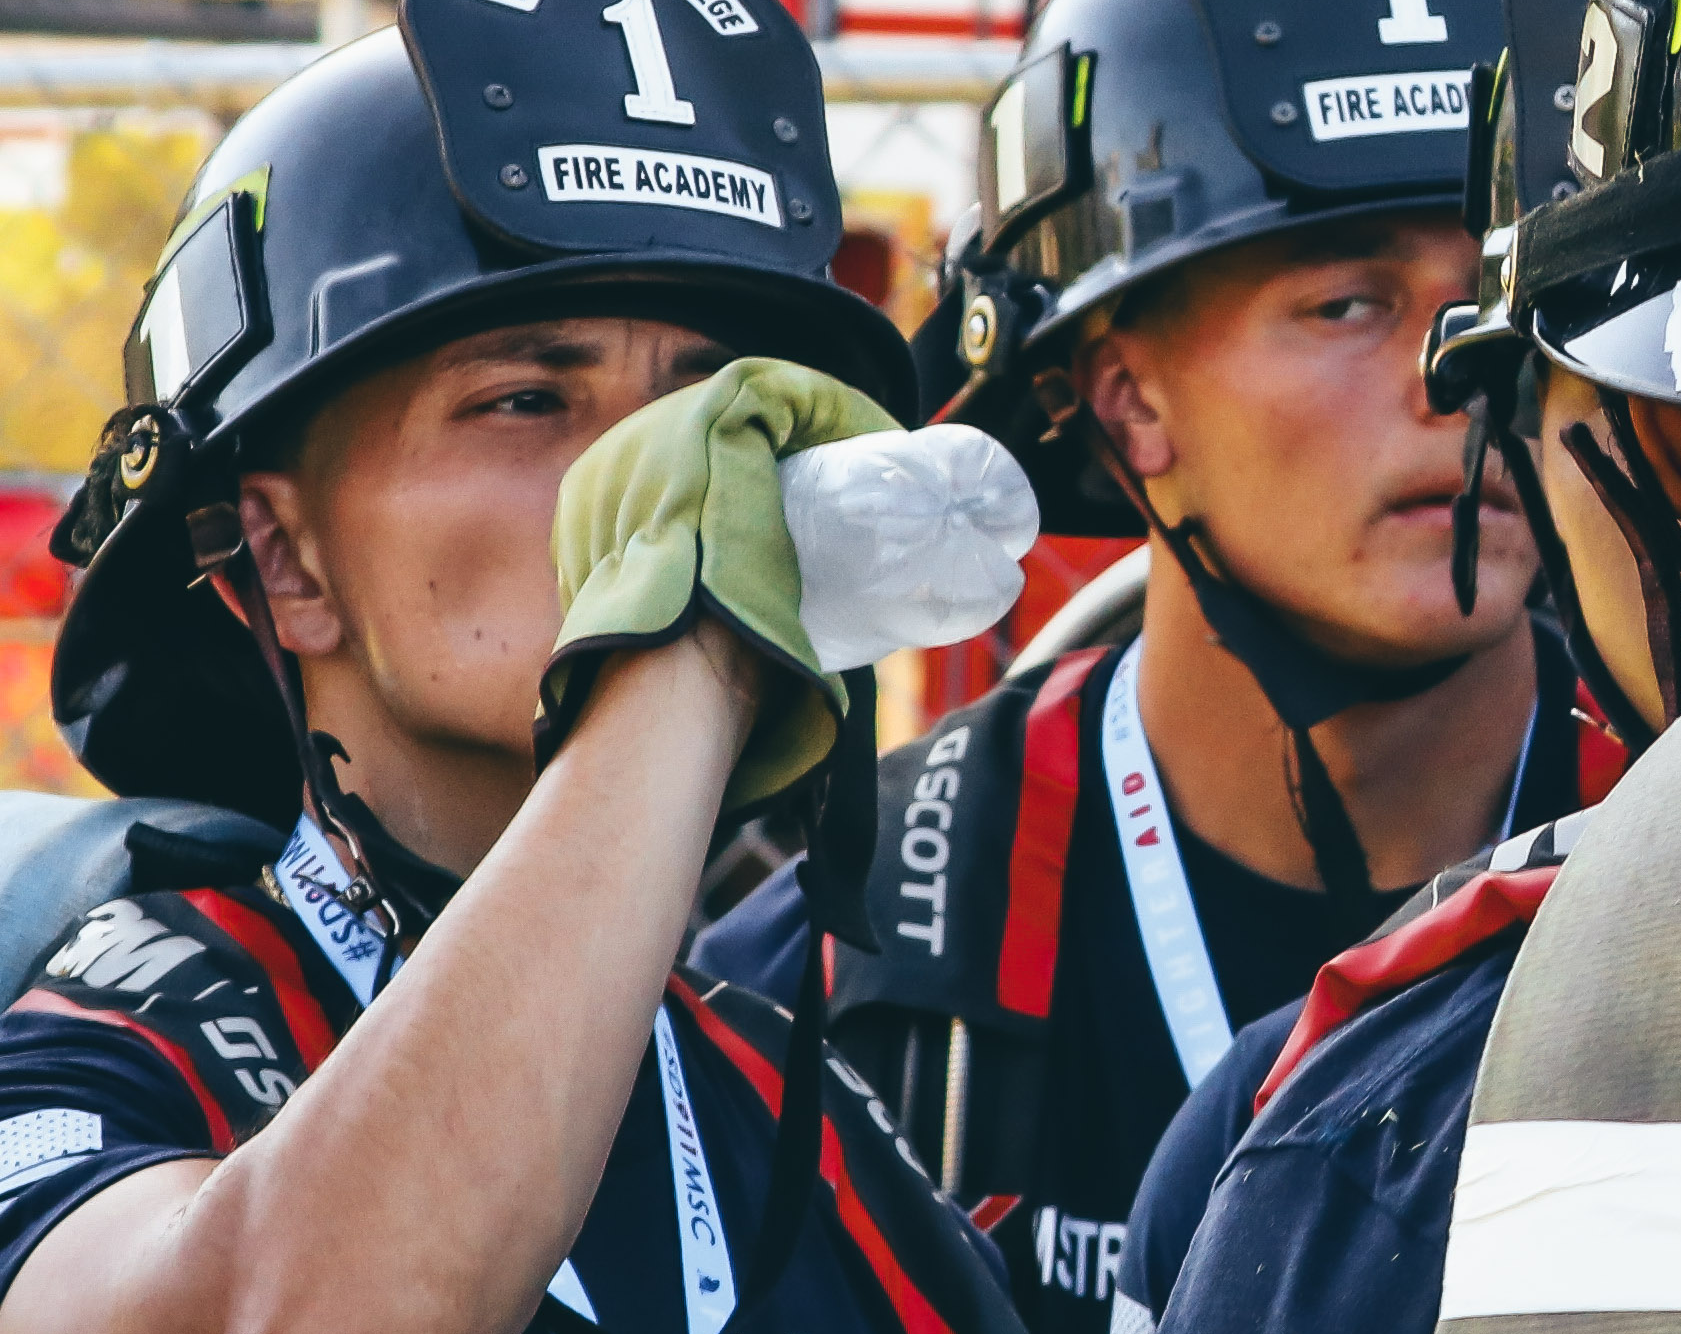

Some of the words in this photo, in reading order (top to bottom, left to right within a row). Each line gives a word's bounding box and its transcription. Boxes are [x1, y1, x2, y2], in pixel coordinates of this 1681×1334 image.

[1318, 87, 1383, 125] FIRE
[1393, 80, 1472, 118] ACAD
[552, 156, 625, 191] FIRE
[634, 160, 766, 214] ACADEMY
[1122, 771, 1161, 847] AID
[897, 765, 960, 958] SCOTT
